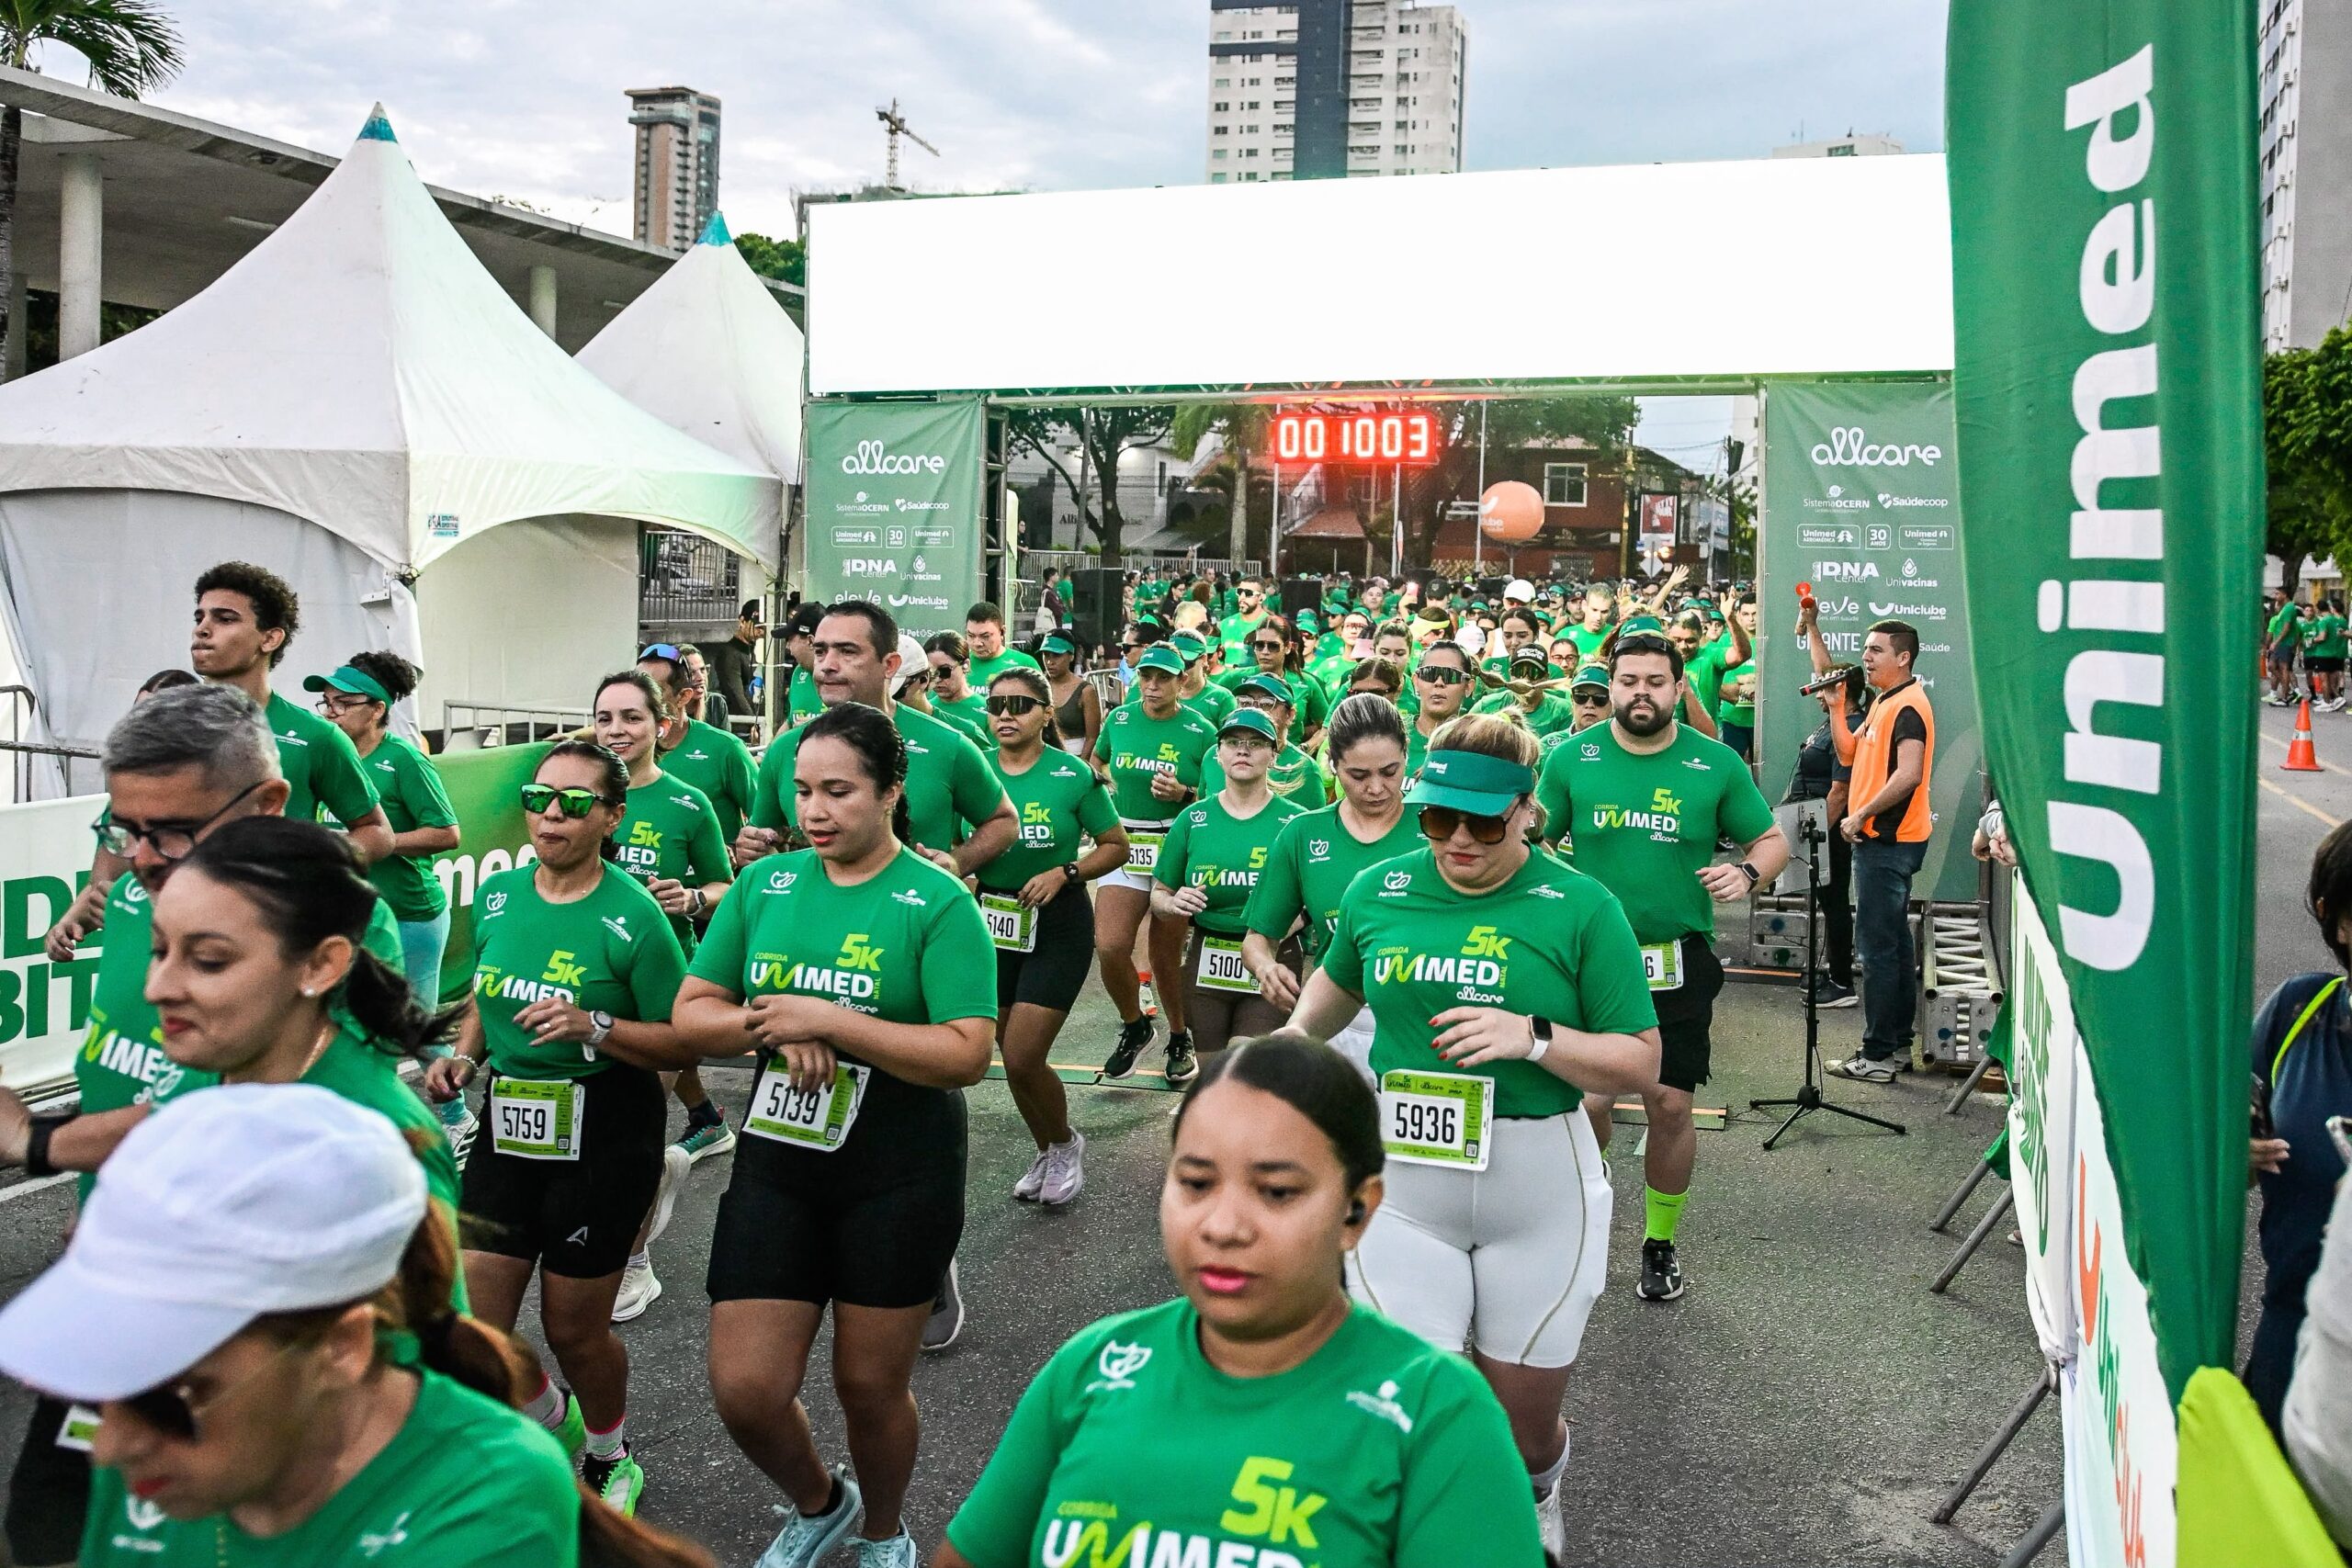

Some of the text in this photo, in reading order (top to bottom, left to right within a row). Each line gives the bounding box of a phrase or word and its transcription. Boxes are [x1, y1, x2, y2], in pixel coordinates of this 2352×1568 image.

[842, 440, 944, 474] allcare
[1811, 426, 1942, 466] allcare
[2037, 43, 2164, 972] Unimed
[888, 530, 903, 540] 30
[1871, 529, 1887, 540] 30
[900, 572, 941, 581] Univacinas
[1885, 578, 1938, 587] Univacinas
[908, 596, 949, 605] Uniclube
[1894, 604, 1946, 615] Uniclube
[1796, 632, 1861, 652] GIANTE
[1918, 643, 1951, 652] Saúde
[1023, 802, 1051, 823] 5K
[1651, 788, 1682, 815] 5K
[1593, 809, 1677, 832] UNIMED
[628, 821, 662, 848] 5K
[1249, 847, 1268, 868] 5
[1192, 869, 1259, 886] UNIME
[988, 913, 1014, 938] 5140
[836, 933, 885, 971] 5K
[1377, 946, 1408, 956] CORRIDA
[1461, 925, 1512, 960] 5K
[542, 950, 587, 987] 5K
[754, 952, 788, 962] CORRIDA
[1209, 953, 1243, 979] 5100
[1374, 953, 1500, 986] UNIMED
[751, 962, 874, 998] UNIMED
[1456, 986, 1504, 1004] allcare
[766, 1081, 820, 1125] 5139
[503, 1105, 547, 1141] 5759
[1395, 1101, 1455, 1145] 5936
[1220, 1456, 1328, 1549] 5K
